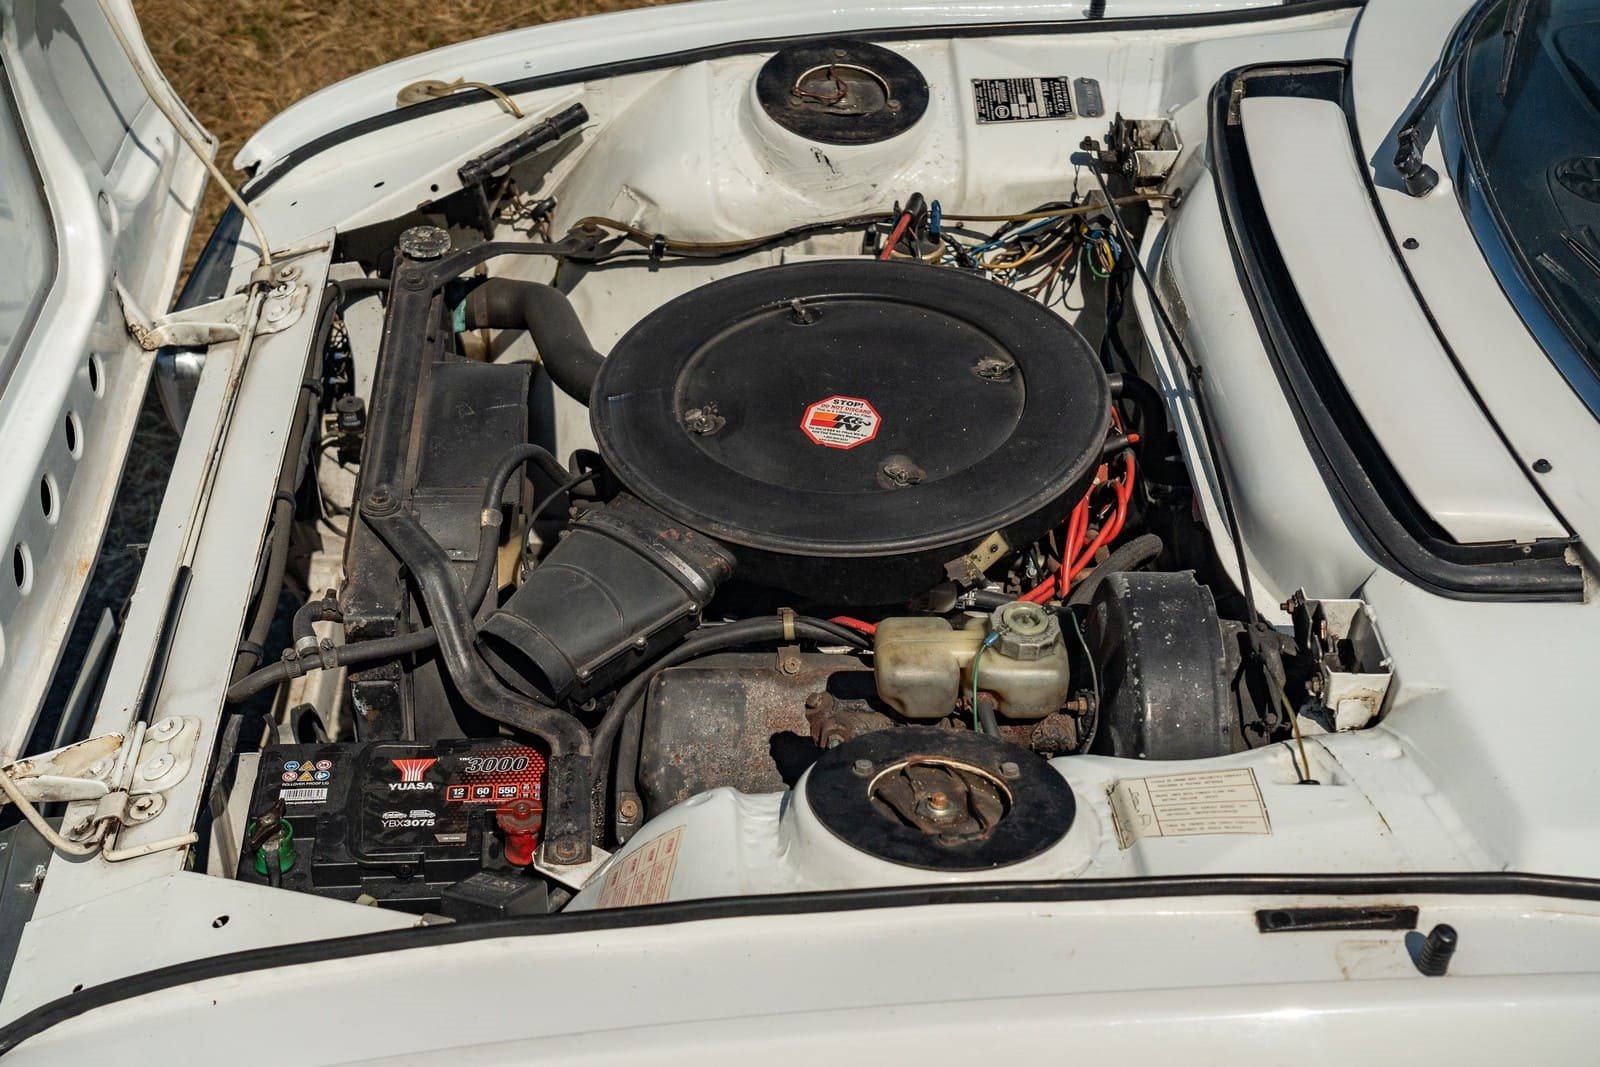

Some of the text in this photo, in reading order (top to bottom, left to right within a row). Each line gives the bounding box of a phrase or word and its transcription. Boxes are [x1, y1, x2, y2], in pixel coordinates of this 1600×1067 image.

[832, 399, 864, 408] STOP!
[845, 406, 872, 414] DISCARD
[832, 414, 872, 431] K&N
[465, 757, 530, 773] 3000
[388, 782, 434, 791] YUASA
[476, 787, 490, 795] 60
[498, 786, 517, 794] 550
[453, 788, 465, 796] 12
[381, 819, 435, 828] YBX3075
